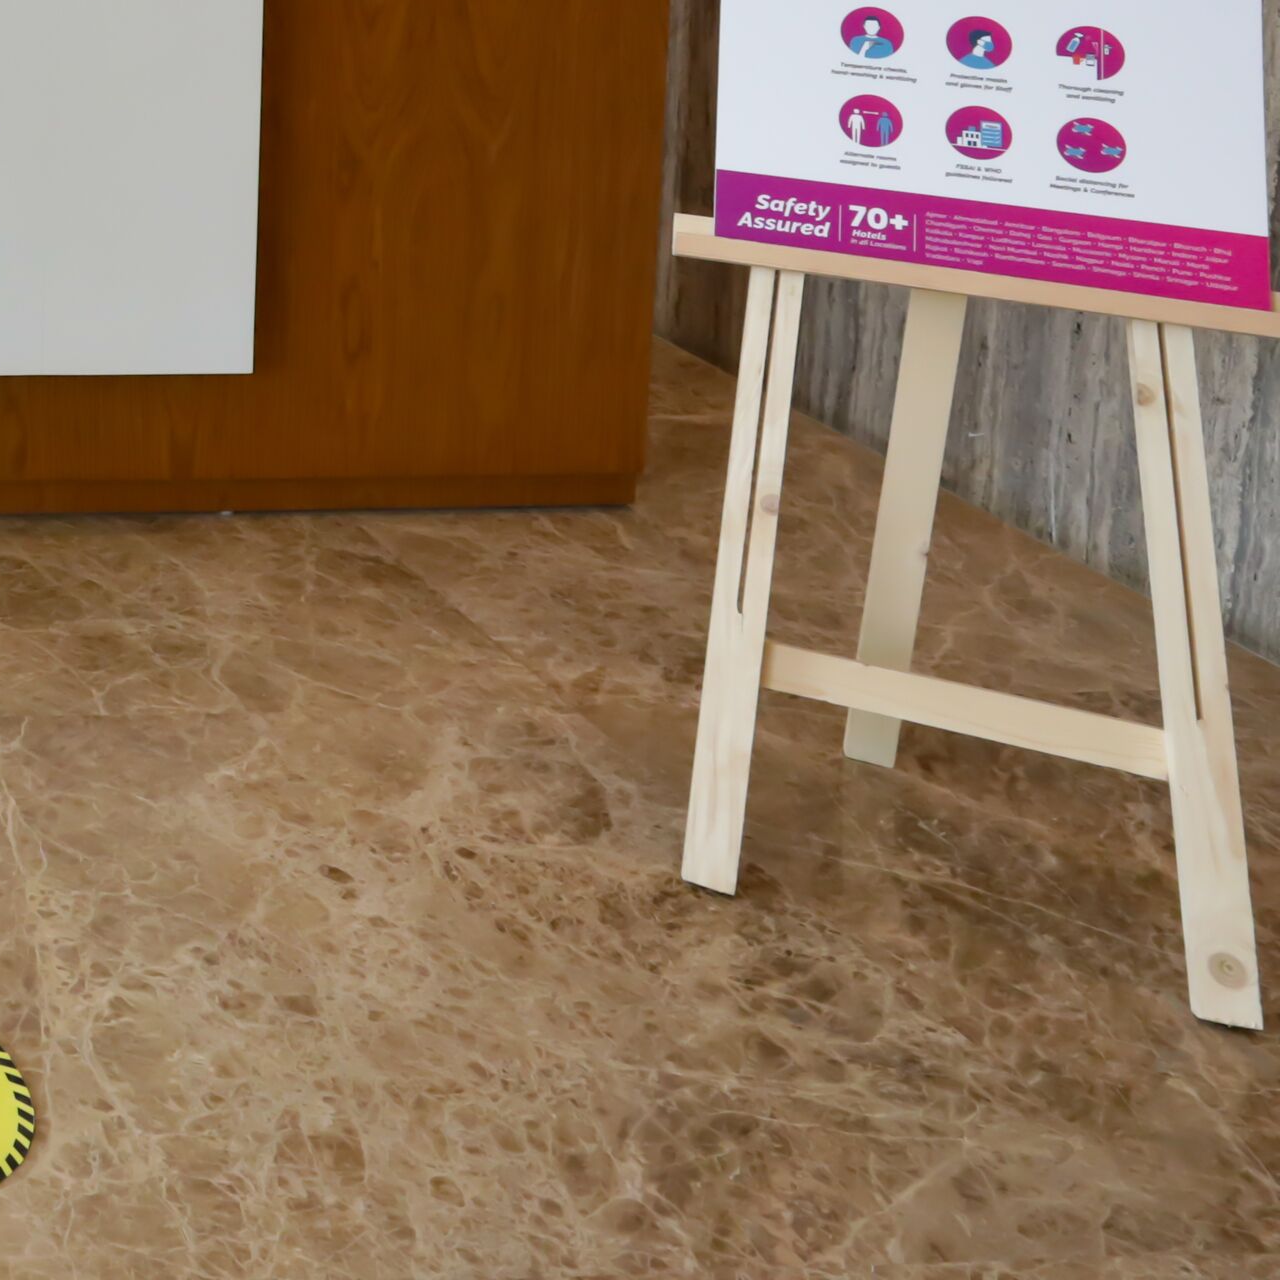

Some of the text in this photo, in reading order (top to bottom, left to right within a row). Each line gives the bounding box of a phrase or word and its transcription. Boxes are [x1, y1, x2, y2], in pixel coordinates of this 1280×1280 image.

[755, 194, 831, 220] Safety
[848, 204, 909, 230] 70+
[737, 212, 830, 238] Assured
[852, 229, 886, 241] Hotels
